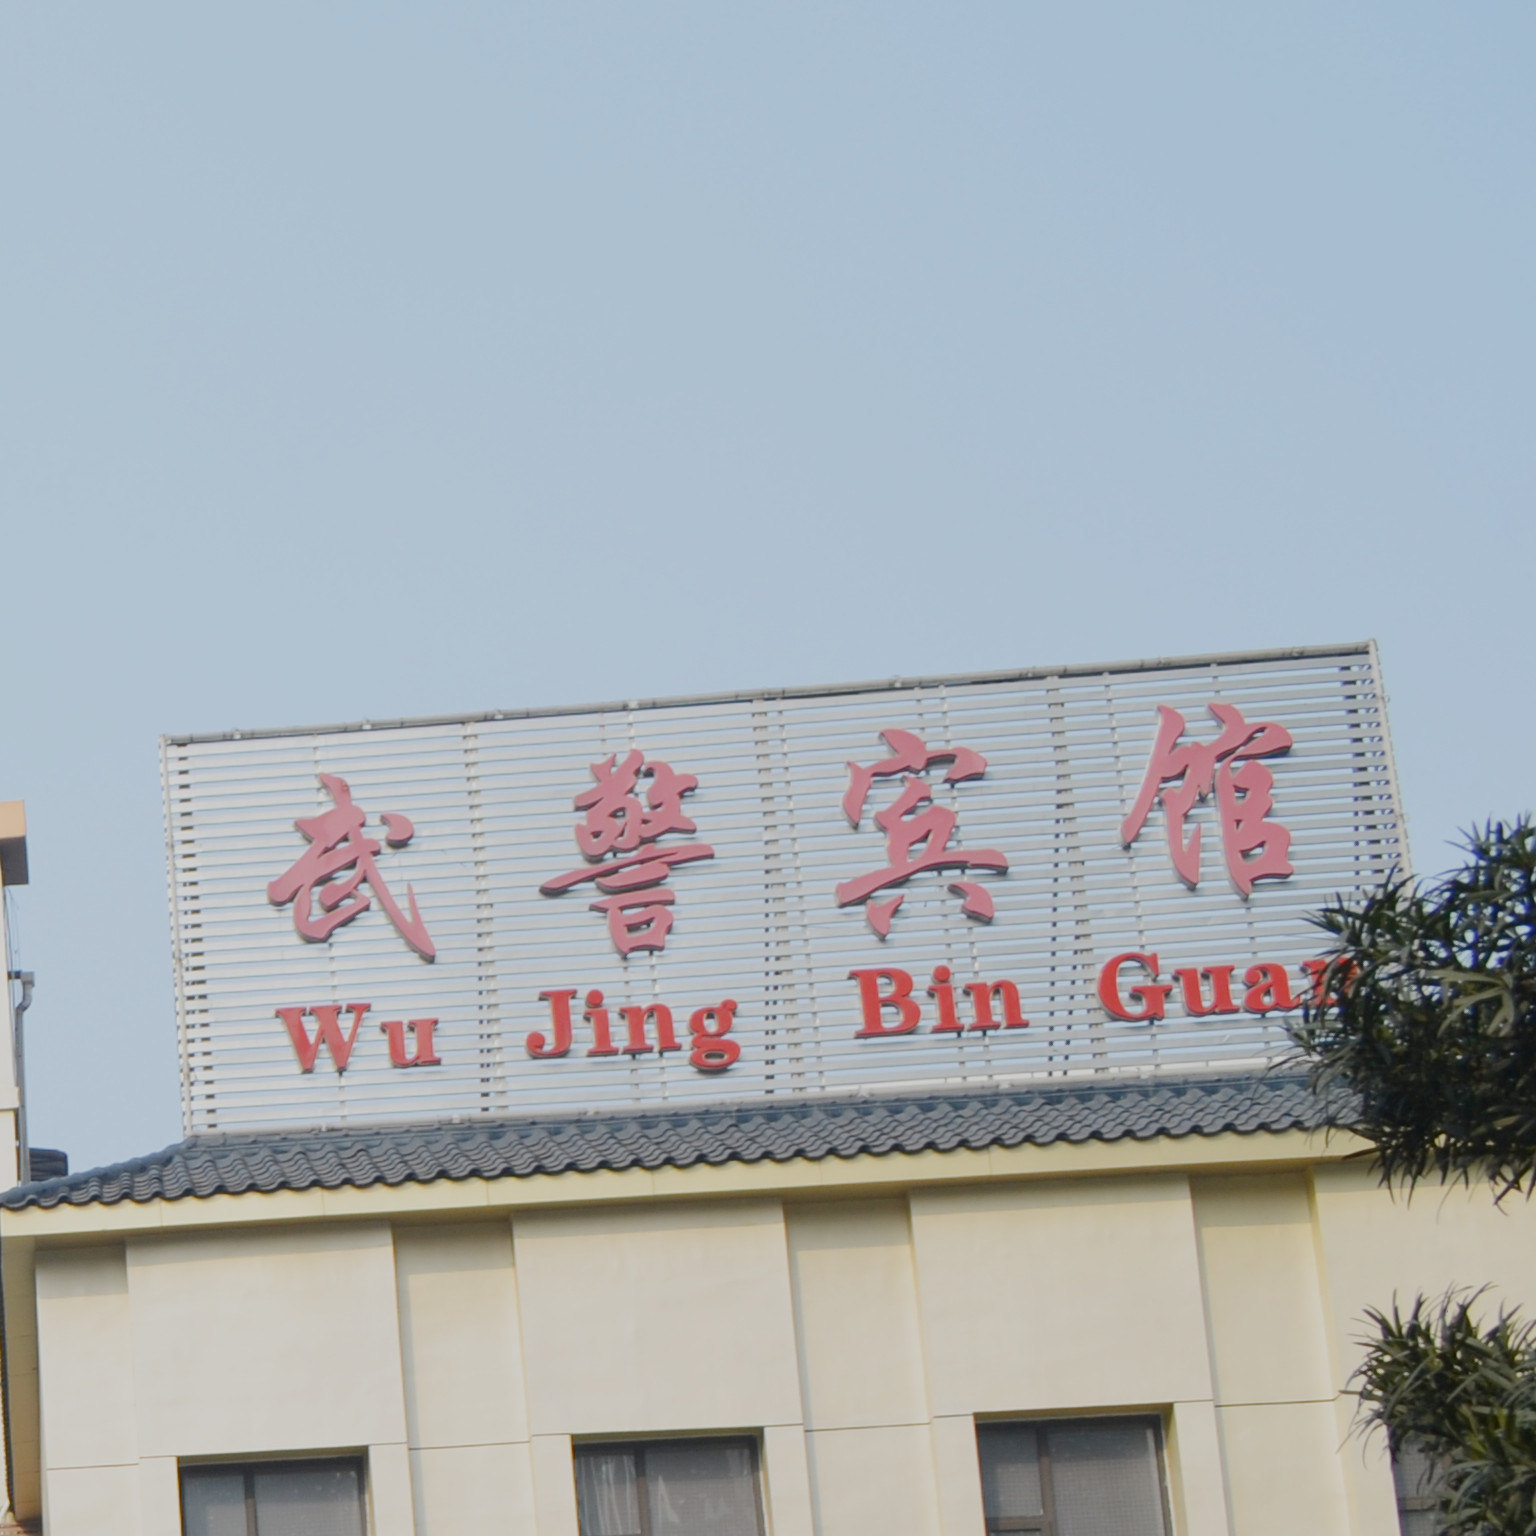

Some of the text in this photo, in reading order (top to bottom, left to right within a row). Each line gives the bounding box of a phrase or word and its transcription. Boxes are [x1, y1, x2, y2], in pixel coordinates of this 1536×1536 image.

[267, 702, 1295, 962] 武警宾馆
[275, 1002, 440, 1073] Wu
[525, 988, 743, 1071] Jing
[849, 964, 1030, 1040] Bin
